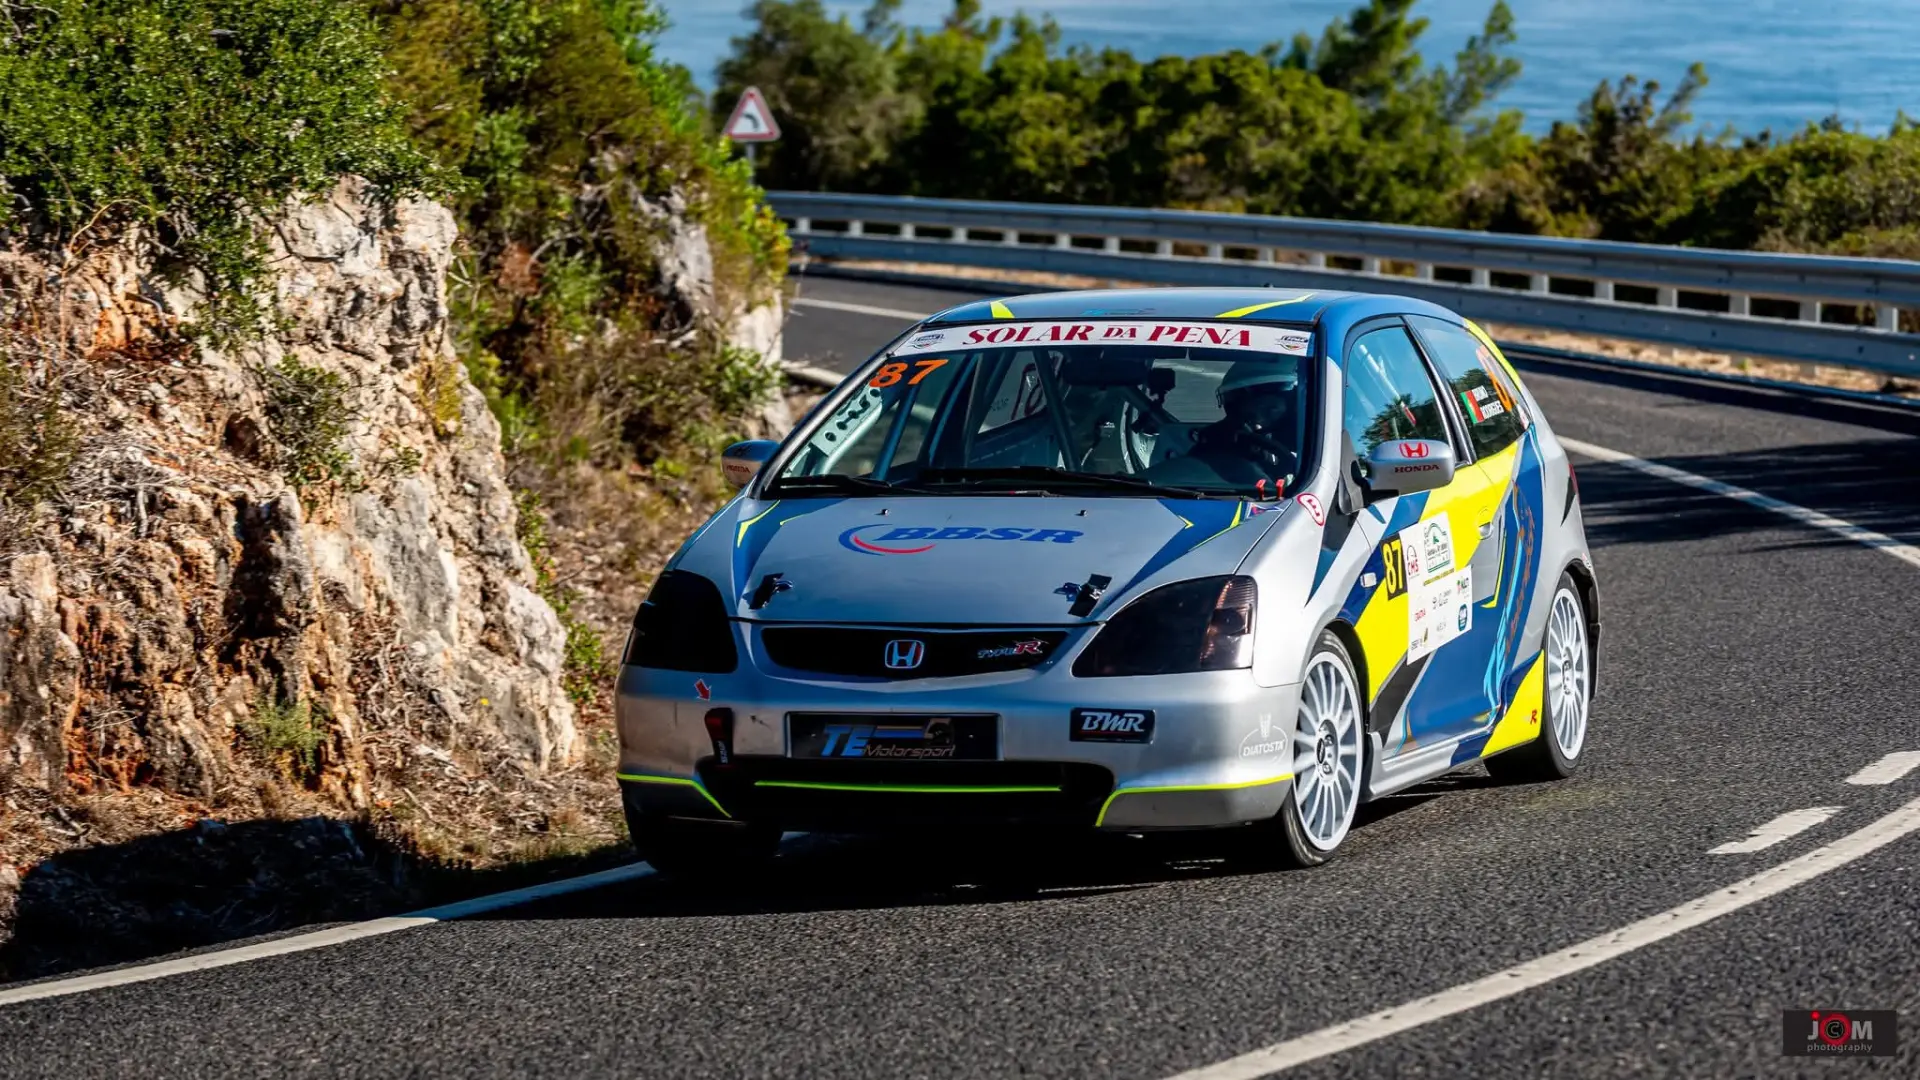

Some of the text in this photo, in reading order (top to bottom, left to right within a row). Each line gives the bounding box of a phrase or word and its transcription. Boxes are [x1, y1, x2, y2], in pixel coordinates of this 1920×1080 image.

[963, 325, 1094, 345] SOLAR
[1103, 327, 1137, 338] DA
[1147, 326, 1251, 346] PENA
[868, 359, 949, 388] 87
[1394, 465, 1440, 473] HONDA
[872, 527, 1084, 543] BBSR
[1383, 539, 1403, 594] 87
[1080, 711, 1145, 732] BMR
[821, 724, 877, 757] TE
[864, 744, 956, 759] Motorsport
